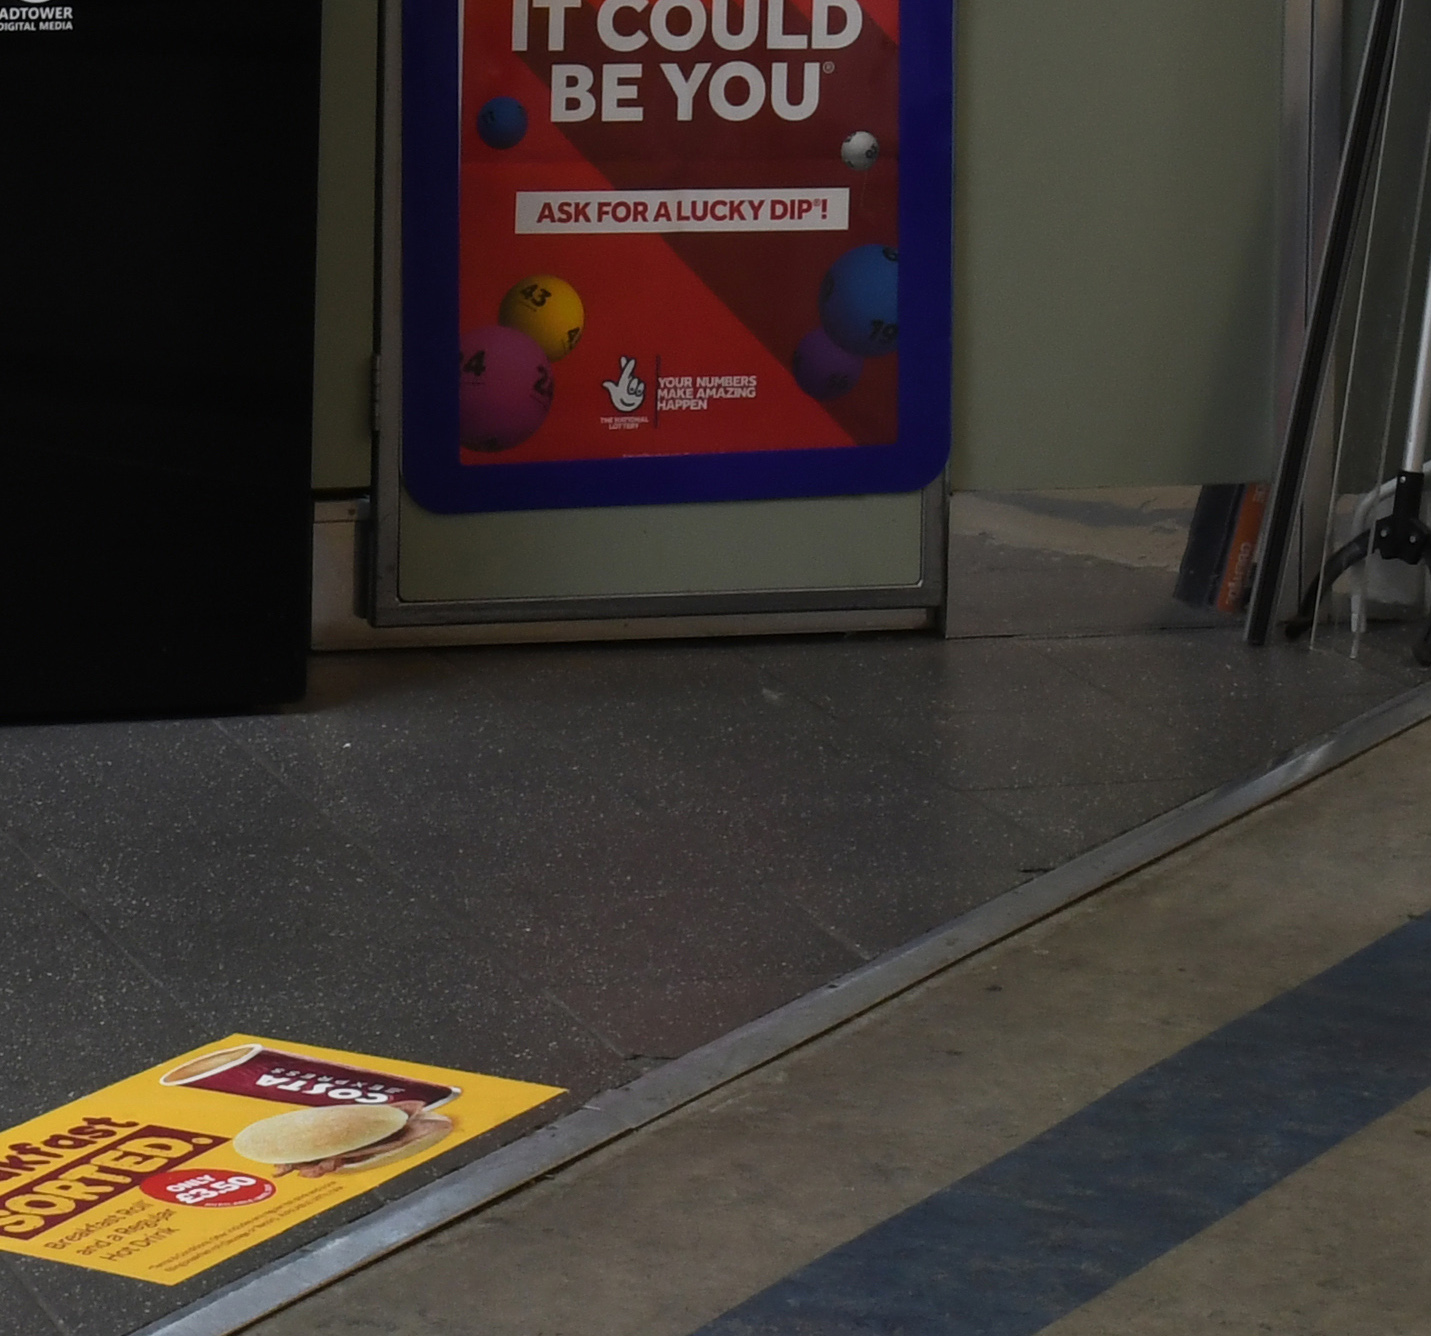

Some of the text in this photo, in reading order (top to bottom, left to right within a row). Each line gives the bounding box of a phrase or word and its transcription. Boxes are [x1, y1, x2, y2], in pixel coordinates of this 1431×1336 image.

[39, 21, 73, 30] MEDIA
[550, 63, 644, 123] BE
[536, 201, 591, 224] ASK
[596, 200, 649, 223] FOR
[653, 200, 673, 222] A
[676, 199, 766, 222] LUCKY
[520, 283, 552, 308] 43
[657, 387, 756, 399] MAKE AMAZING
[658, 375, 757, 388] YOUR NUMBERS
[657, 399, 708, 410] HAPPEN
[255, 1073, 388, 1103] COSTA
[166, 1174, 216, 1193] ONLY
[175, 1176, 257, 1204] £3.50
[44, 1215, 126, 1250] Breakfast
[76, 1208, 177, 1256] and a Regular
[100, 1227, 180, 1261] Hot Drink
